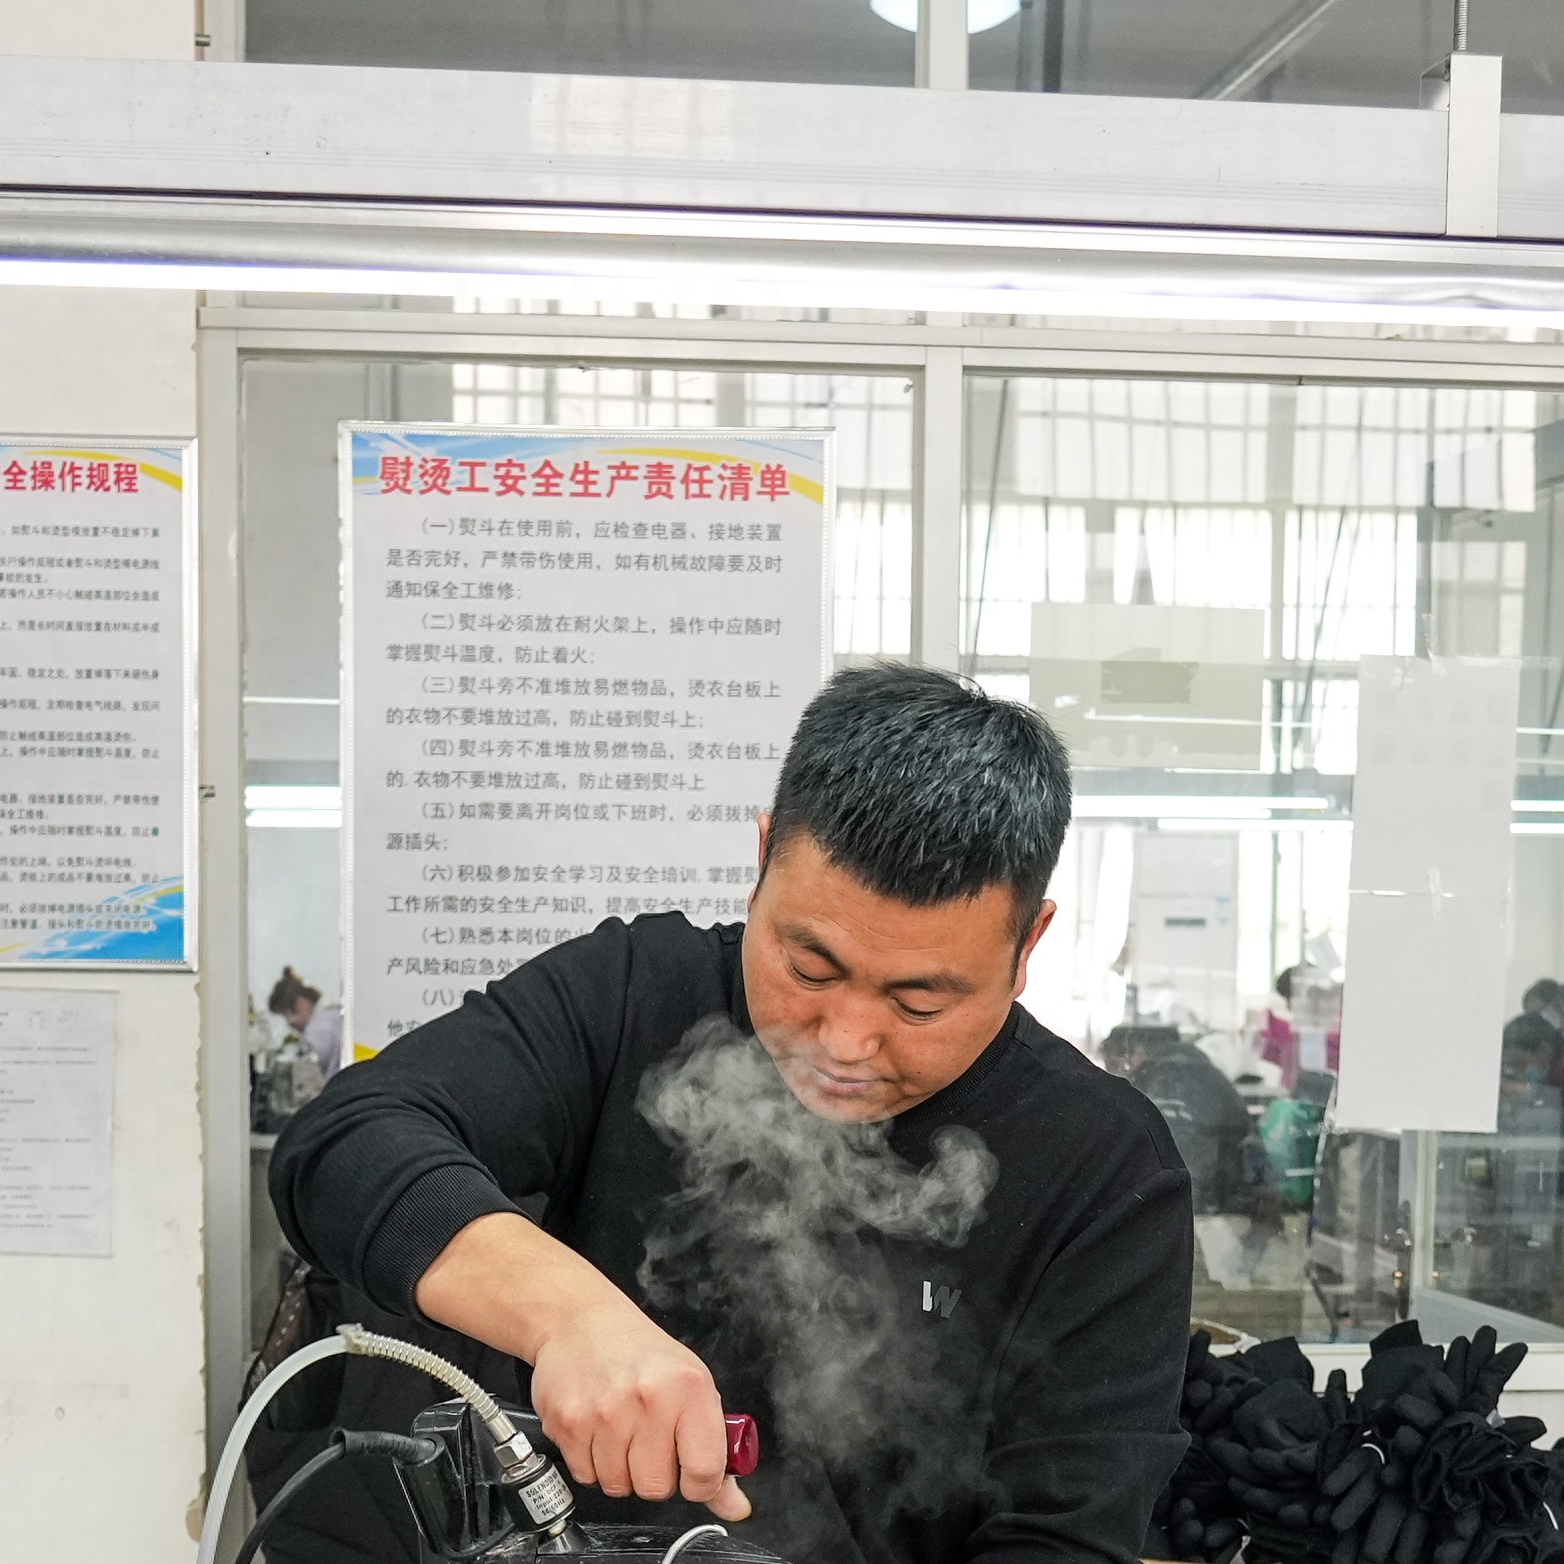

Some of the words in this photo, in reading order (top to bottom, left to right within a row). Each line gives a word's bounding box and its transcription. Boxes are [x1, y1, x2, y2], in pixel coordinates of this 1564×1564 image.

[379, 455, 790, 502] 熨烫工安全生产责任清单
[421, 803, 771, 823] (五)如需要离开岗位或下班时，必须拔掉
